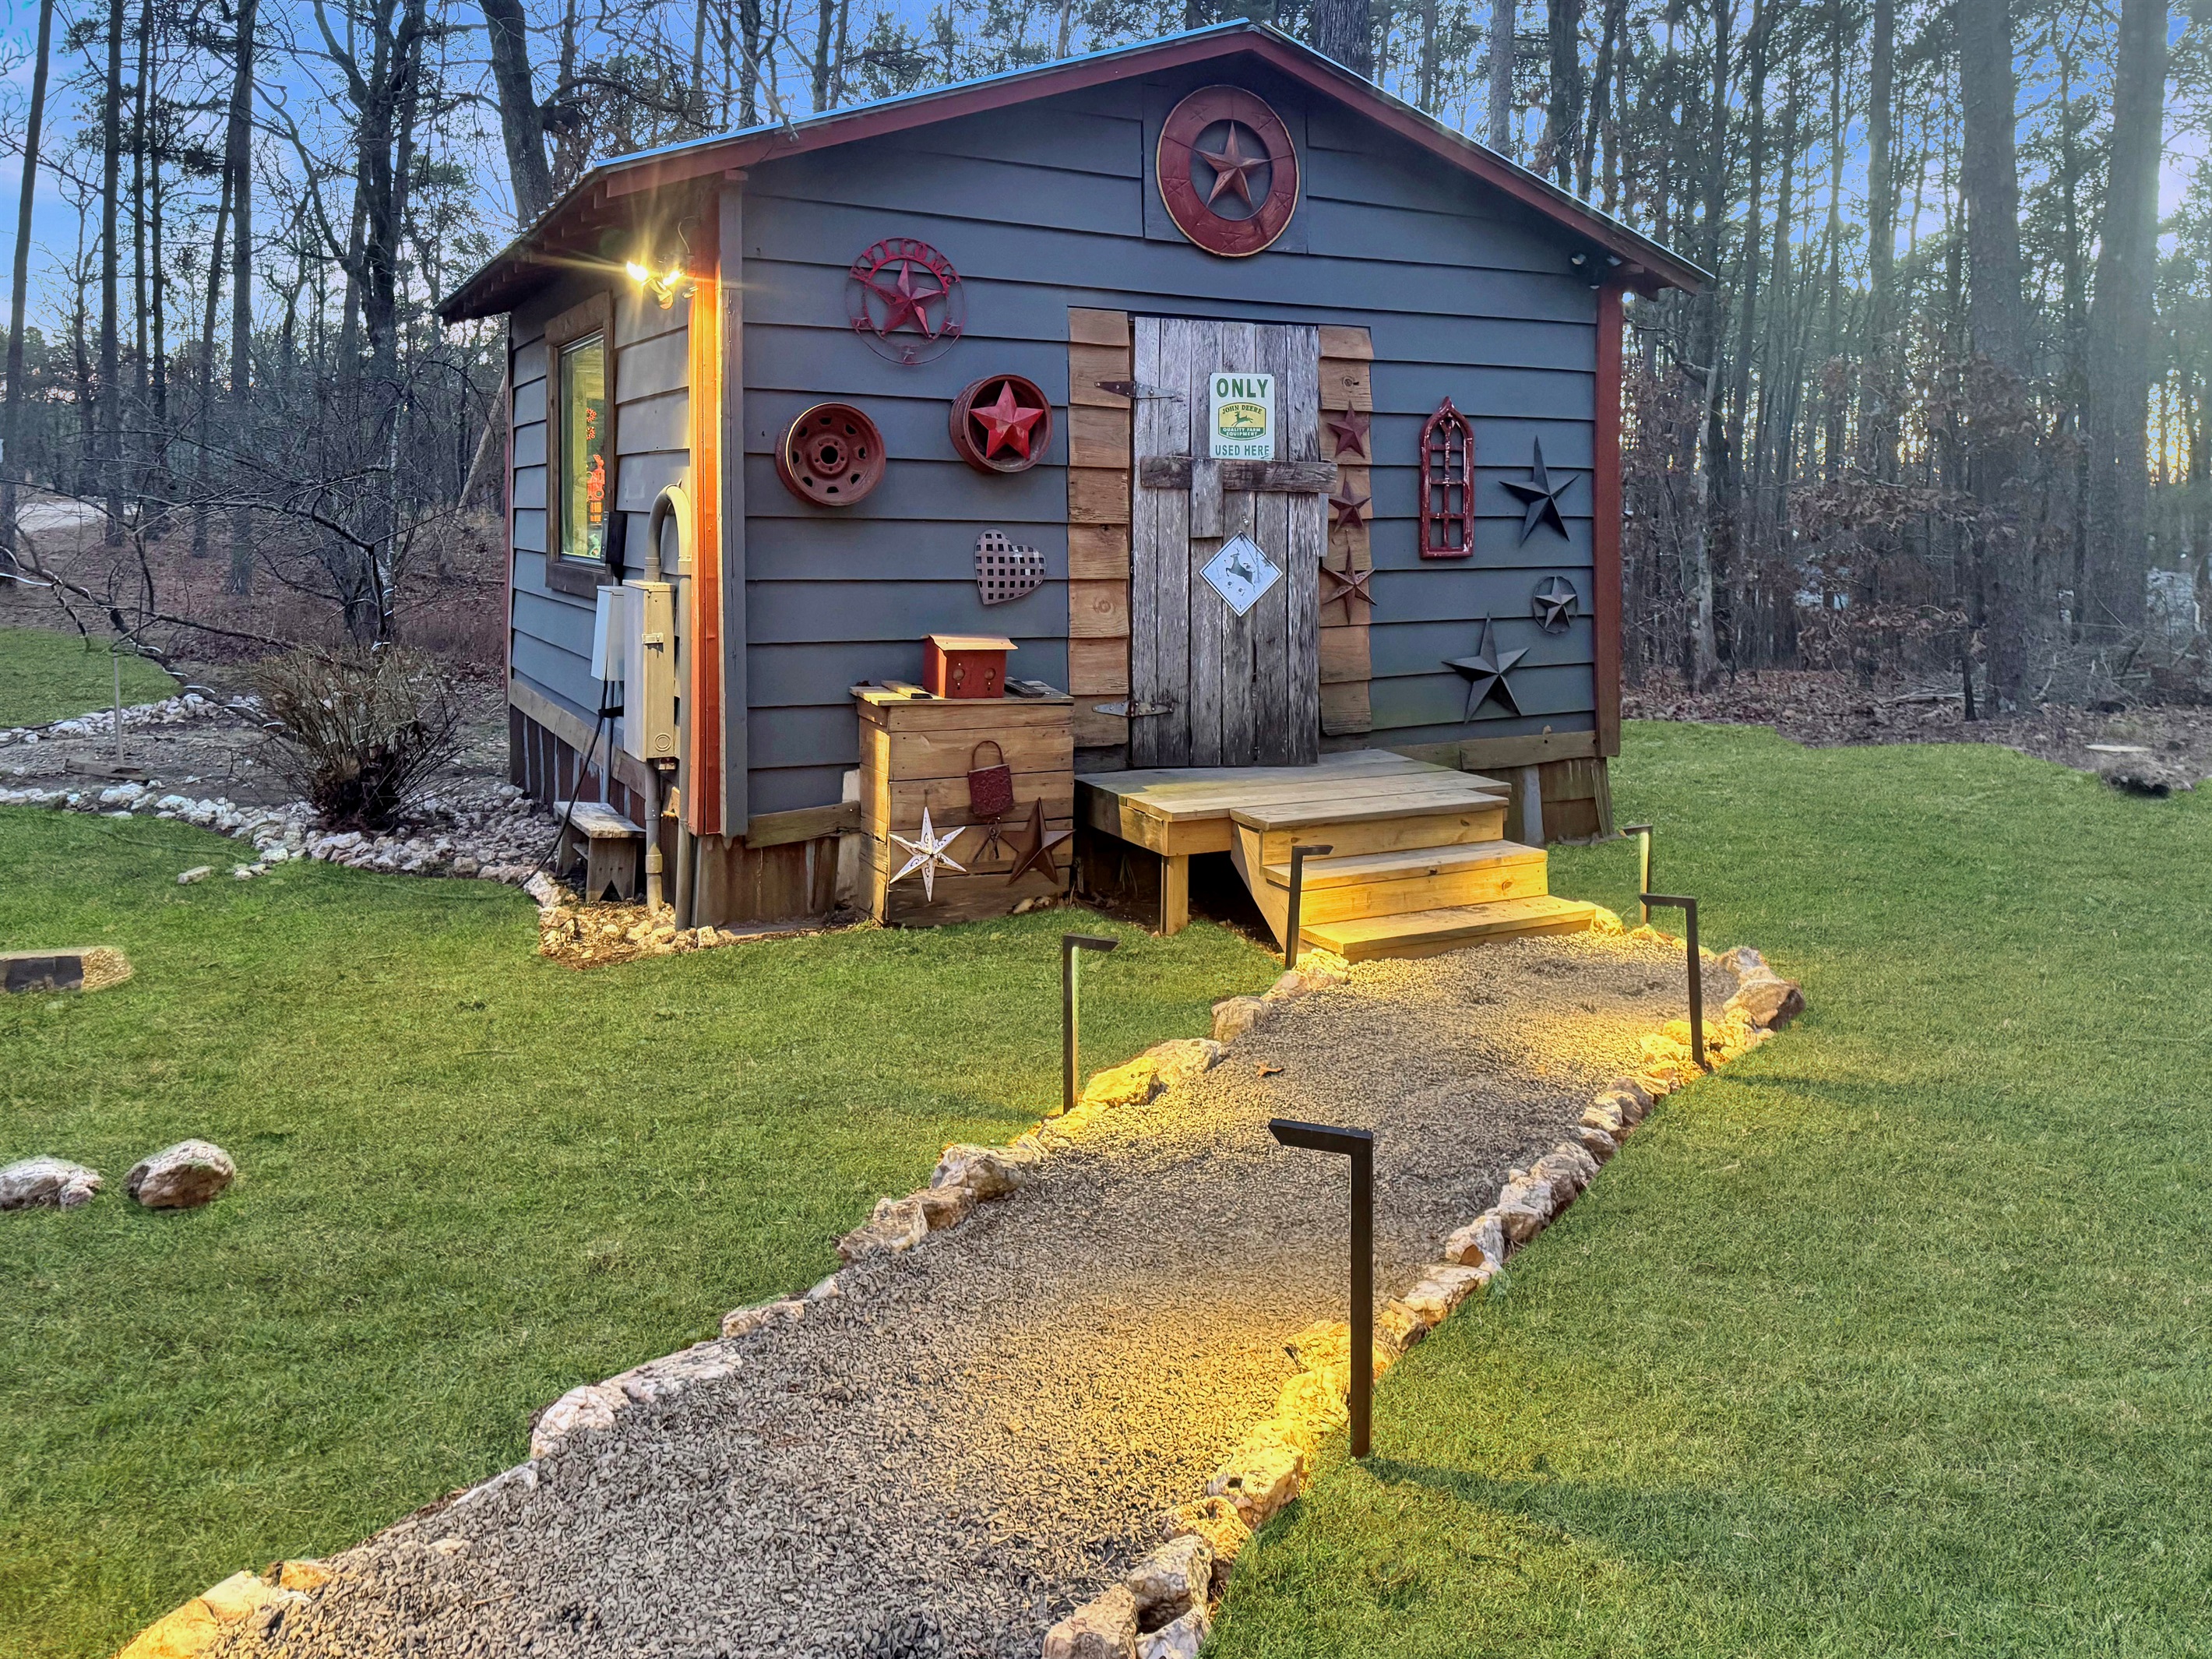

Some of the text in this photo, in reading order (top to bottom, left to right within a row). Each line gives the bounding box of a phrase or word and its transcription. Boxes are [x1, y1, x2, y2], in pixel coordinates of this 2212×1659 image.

[849, 238, 961, 287] WELCOME
[1216, 378, 1269, 399] ONLY
[1222, 404, 1263, 414] JOHN DEERE
[1215, 445, 1270, 456] USED HERE
